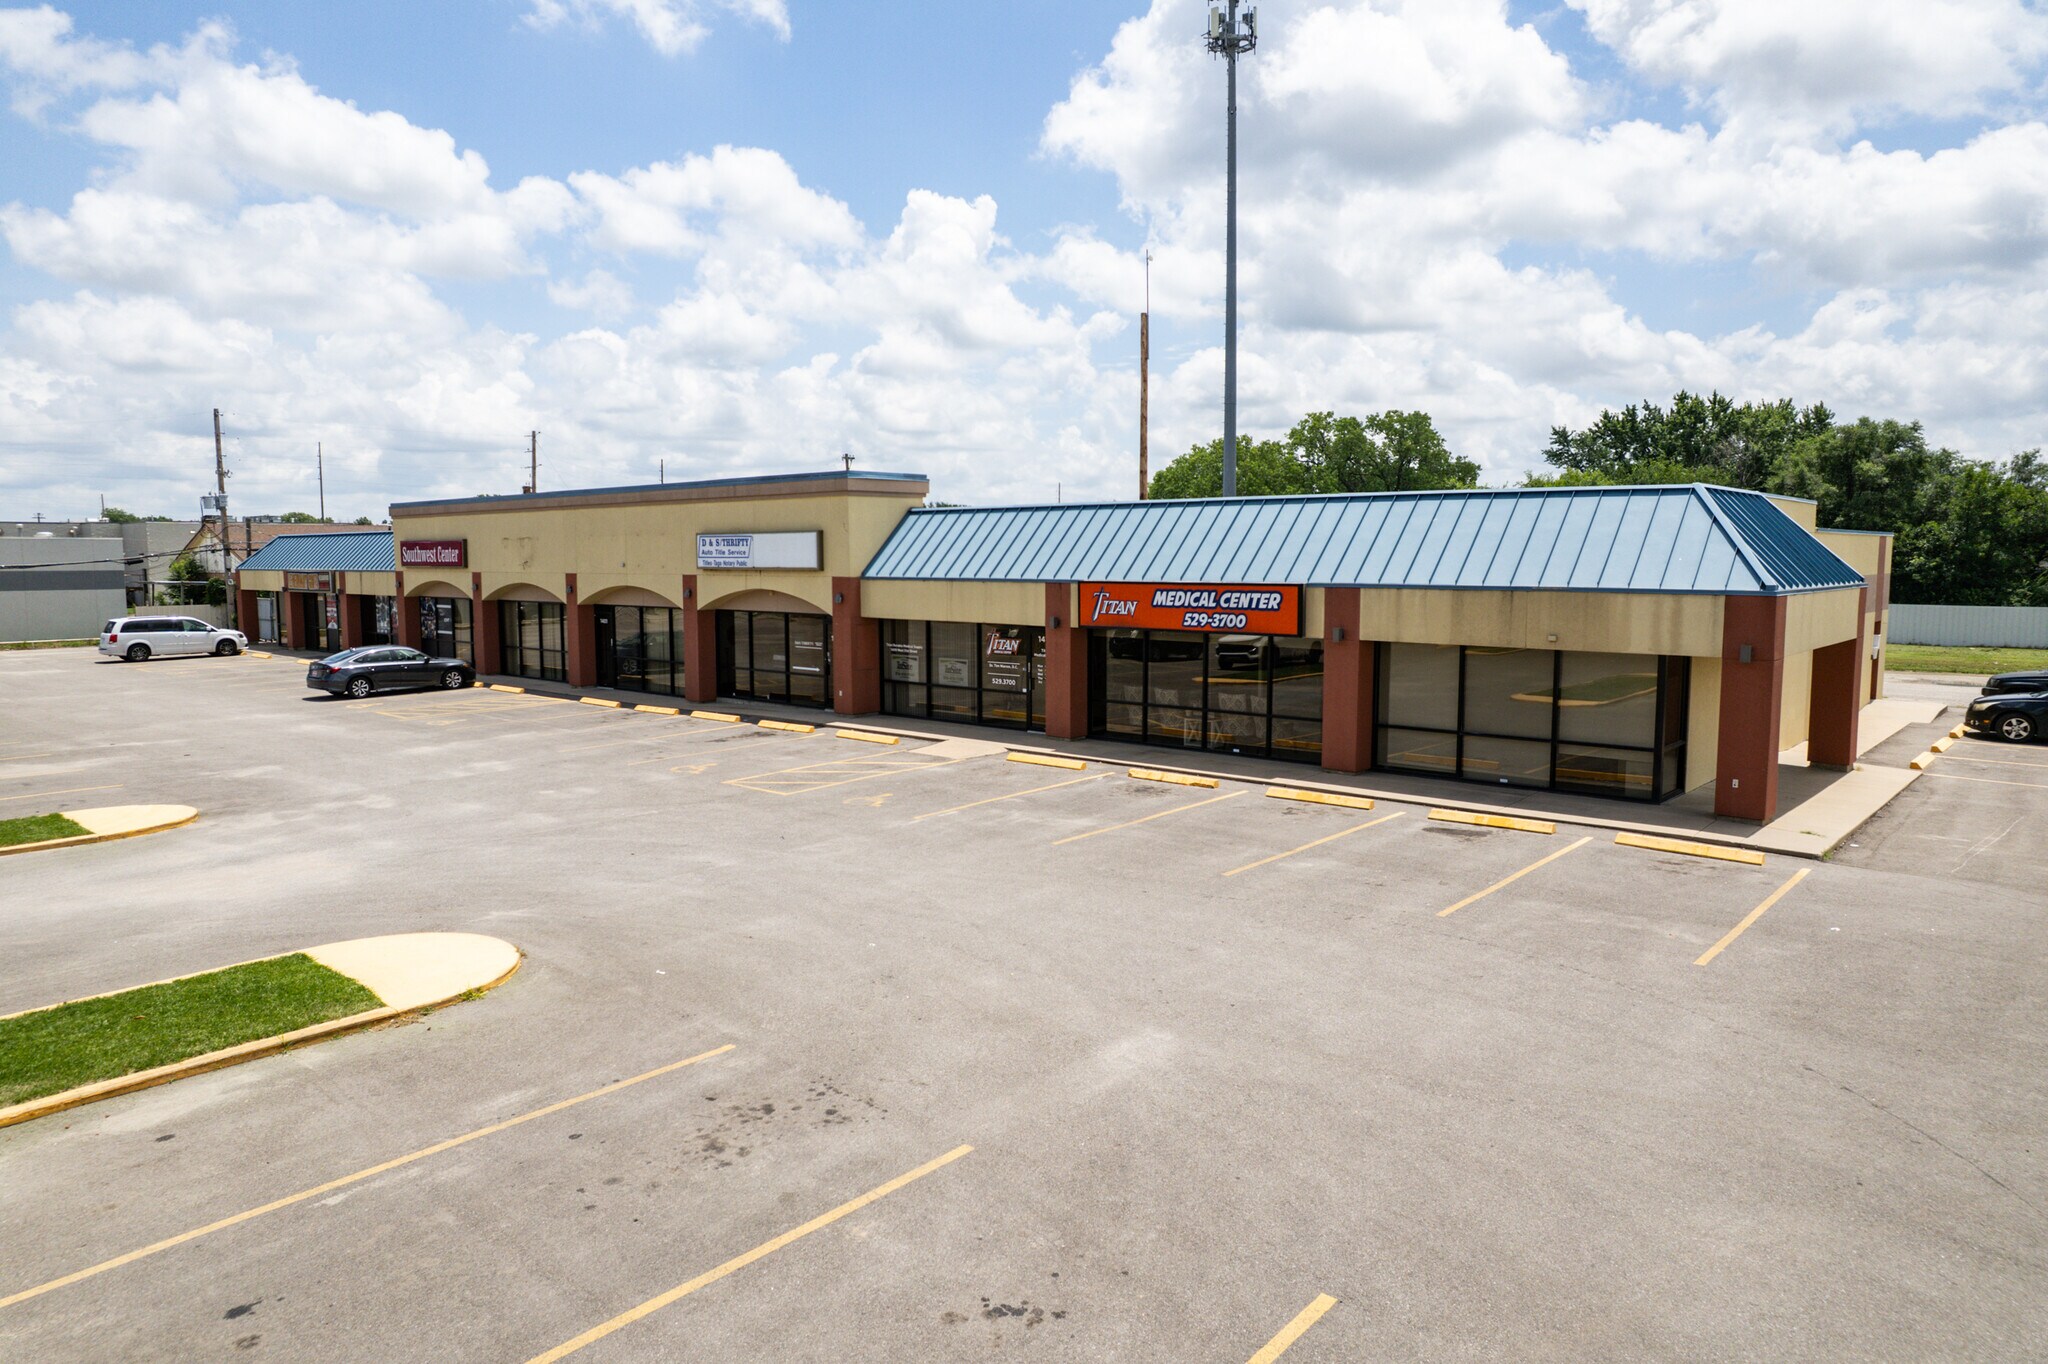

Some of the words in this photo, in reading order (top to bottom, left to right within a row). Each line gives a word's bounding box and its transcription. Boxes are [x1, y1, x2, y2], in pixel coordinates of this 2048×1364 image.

[701, 539, 706, 547] D
[709, 539, 713, 547] &
[402, 546, 436, 562] Southwest
[437, 546, 458, 562] Center
[1152, 590, 1217, 608] MEDICAL
[1219, 591, 1282, 610] CENTER
[1182, 611, 1247, 629] 529-3700
